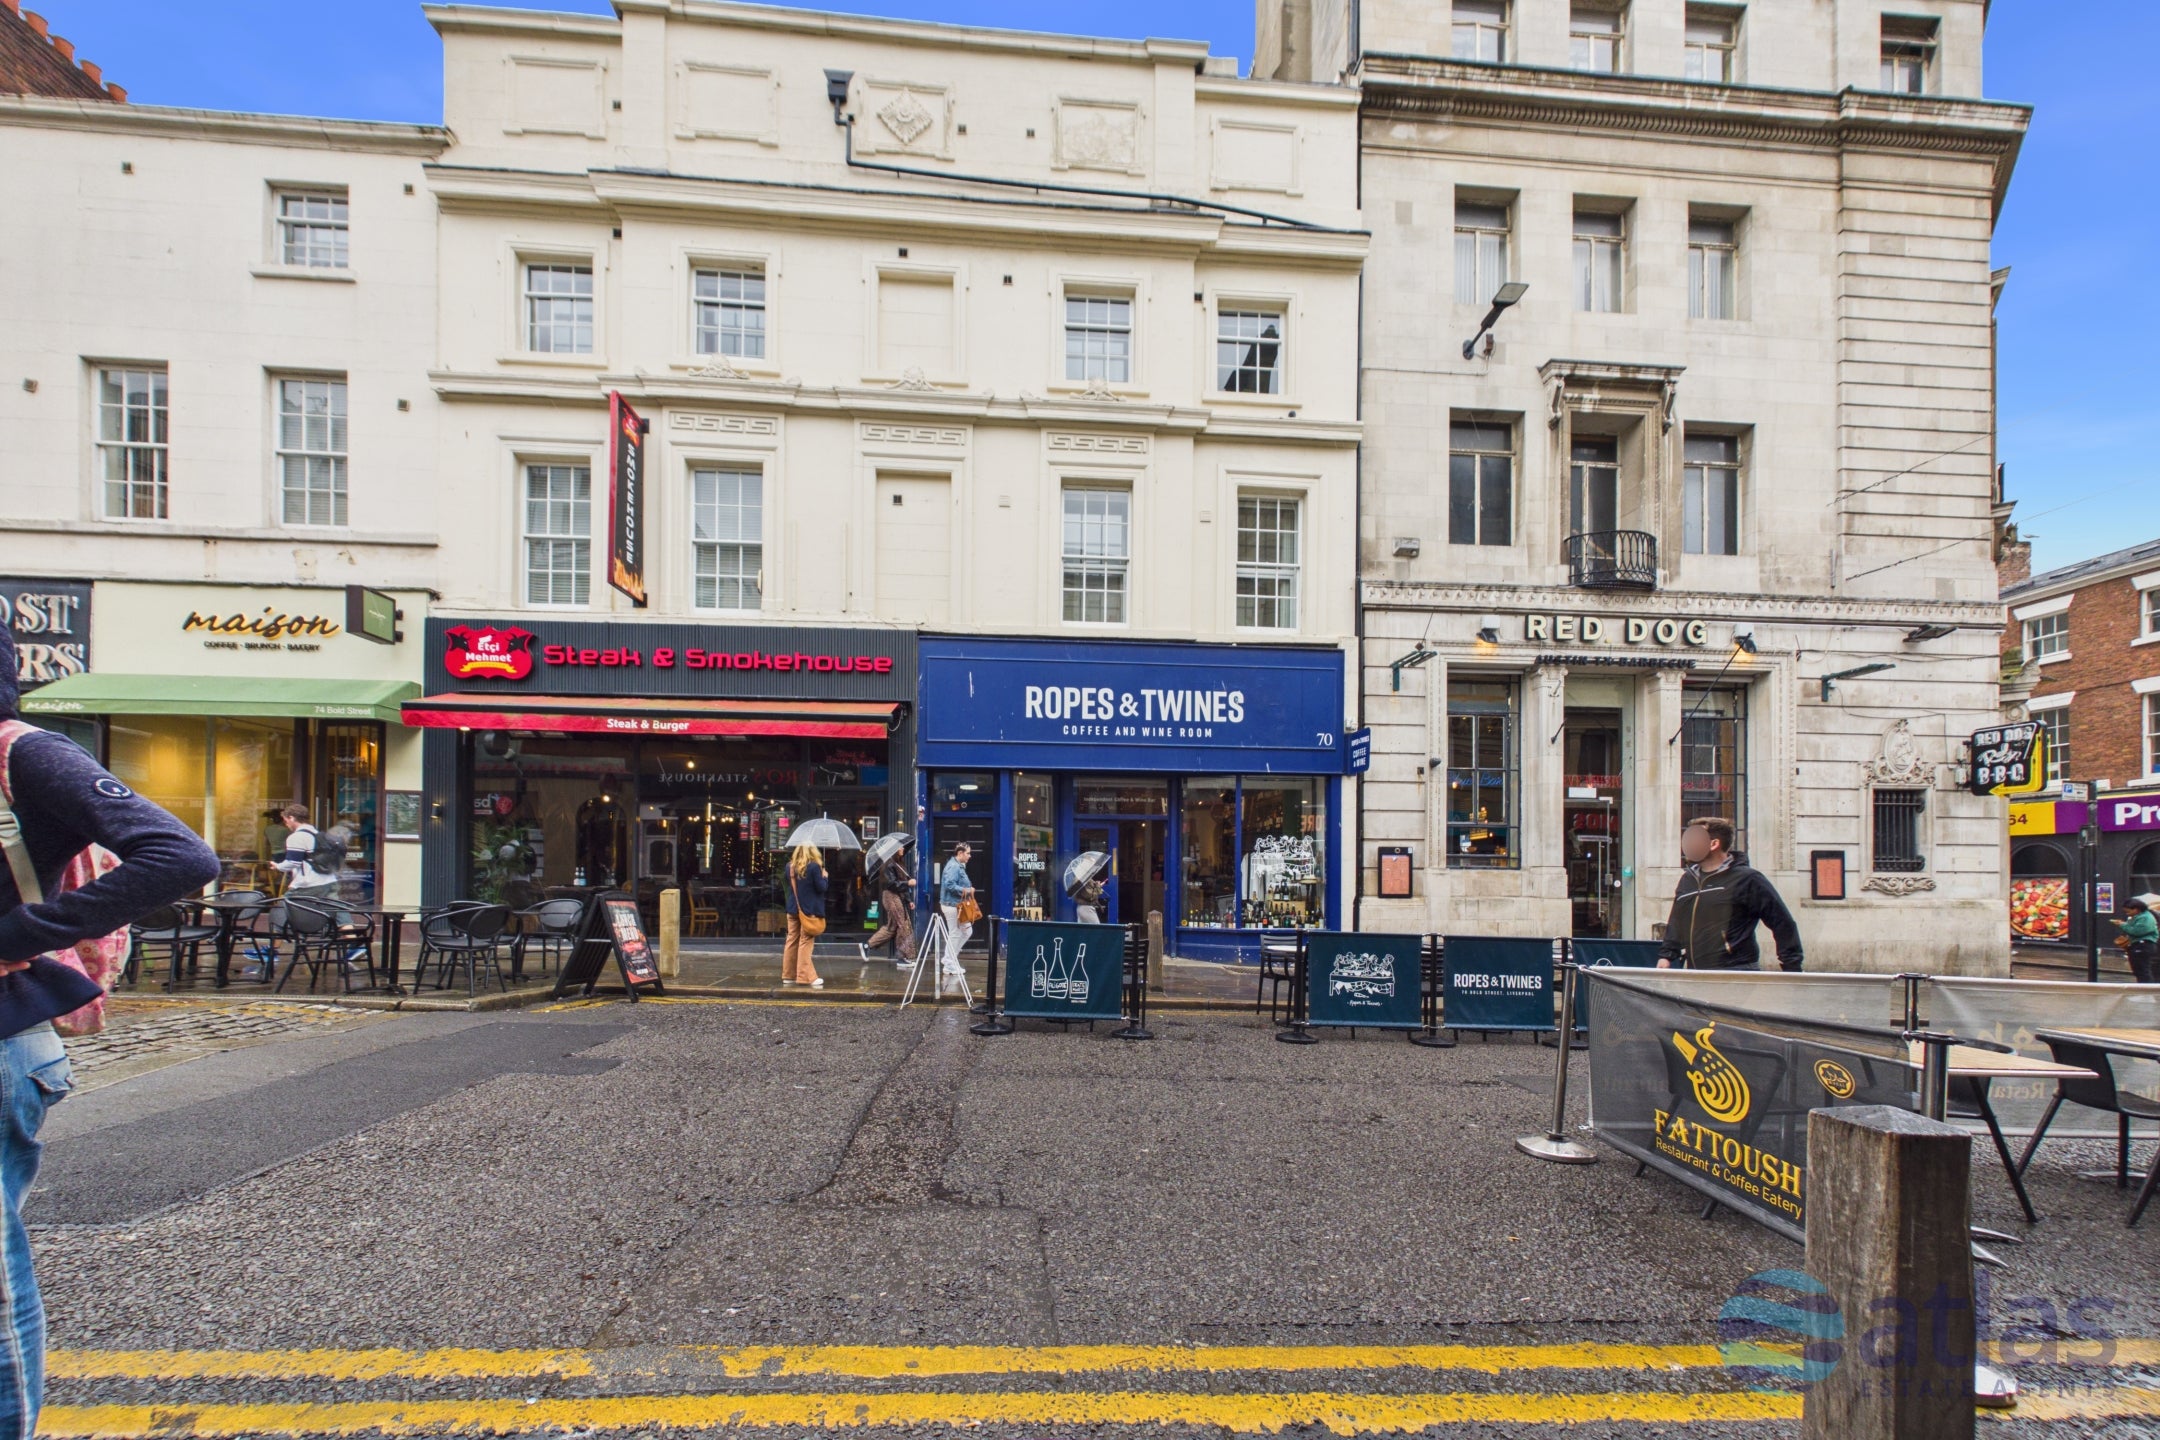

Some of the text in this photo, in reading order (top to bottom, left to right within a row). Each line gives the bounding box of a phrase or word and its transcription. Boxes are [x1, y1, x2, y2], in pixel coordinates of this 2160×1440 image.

[626, 442, 636, 564] SMOKEHOUSE
[182, 606, 340, 639] maison
[1526, 614, 1708, 646] RED DOG
[204, 641, 320, 652] COFFEE BRUNCH BAKERY
[478, 642, 500, 652] Etçi
[15, 643, 84, 682] RS
[466, 652, 512, 662] Mehmet
[543, 645, 893, 673] Steak & Smokehouse
[1535, 654, 1697, 669] AUSTIN TX BARBECUE
[25, 700, 84, 712] maison
[315, 705, 371, 715] 74 Bold Street
[1026, 686, 1245, 724] ROPES & TWINES
[607, 718, 690, 732] Steak & Burger
[1063, 725, 1213, 738] COFFEE AND WINE ROOM
[1316, 732, 1333, 747] 70
[1975, 730, 2001, 746] RED
[1018, 853, 1037, 862] ROPES
[1024, 862, 1045, 870] TWINES
[1453, 973, 1542, 989] ROPES & TWINES
[1654, 1108, 1802, 1199] FATTOUSH
[1655, 1137, 1803, 1221] Restaurant & Coffee Eatery
